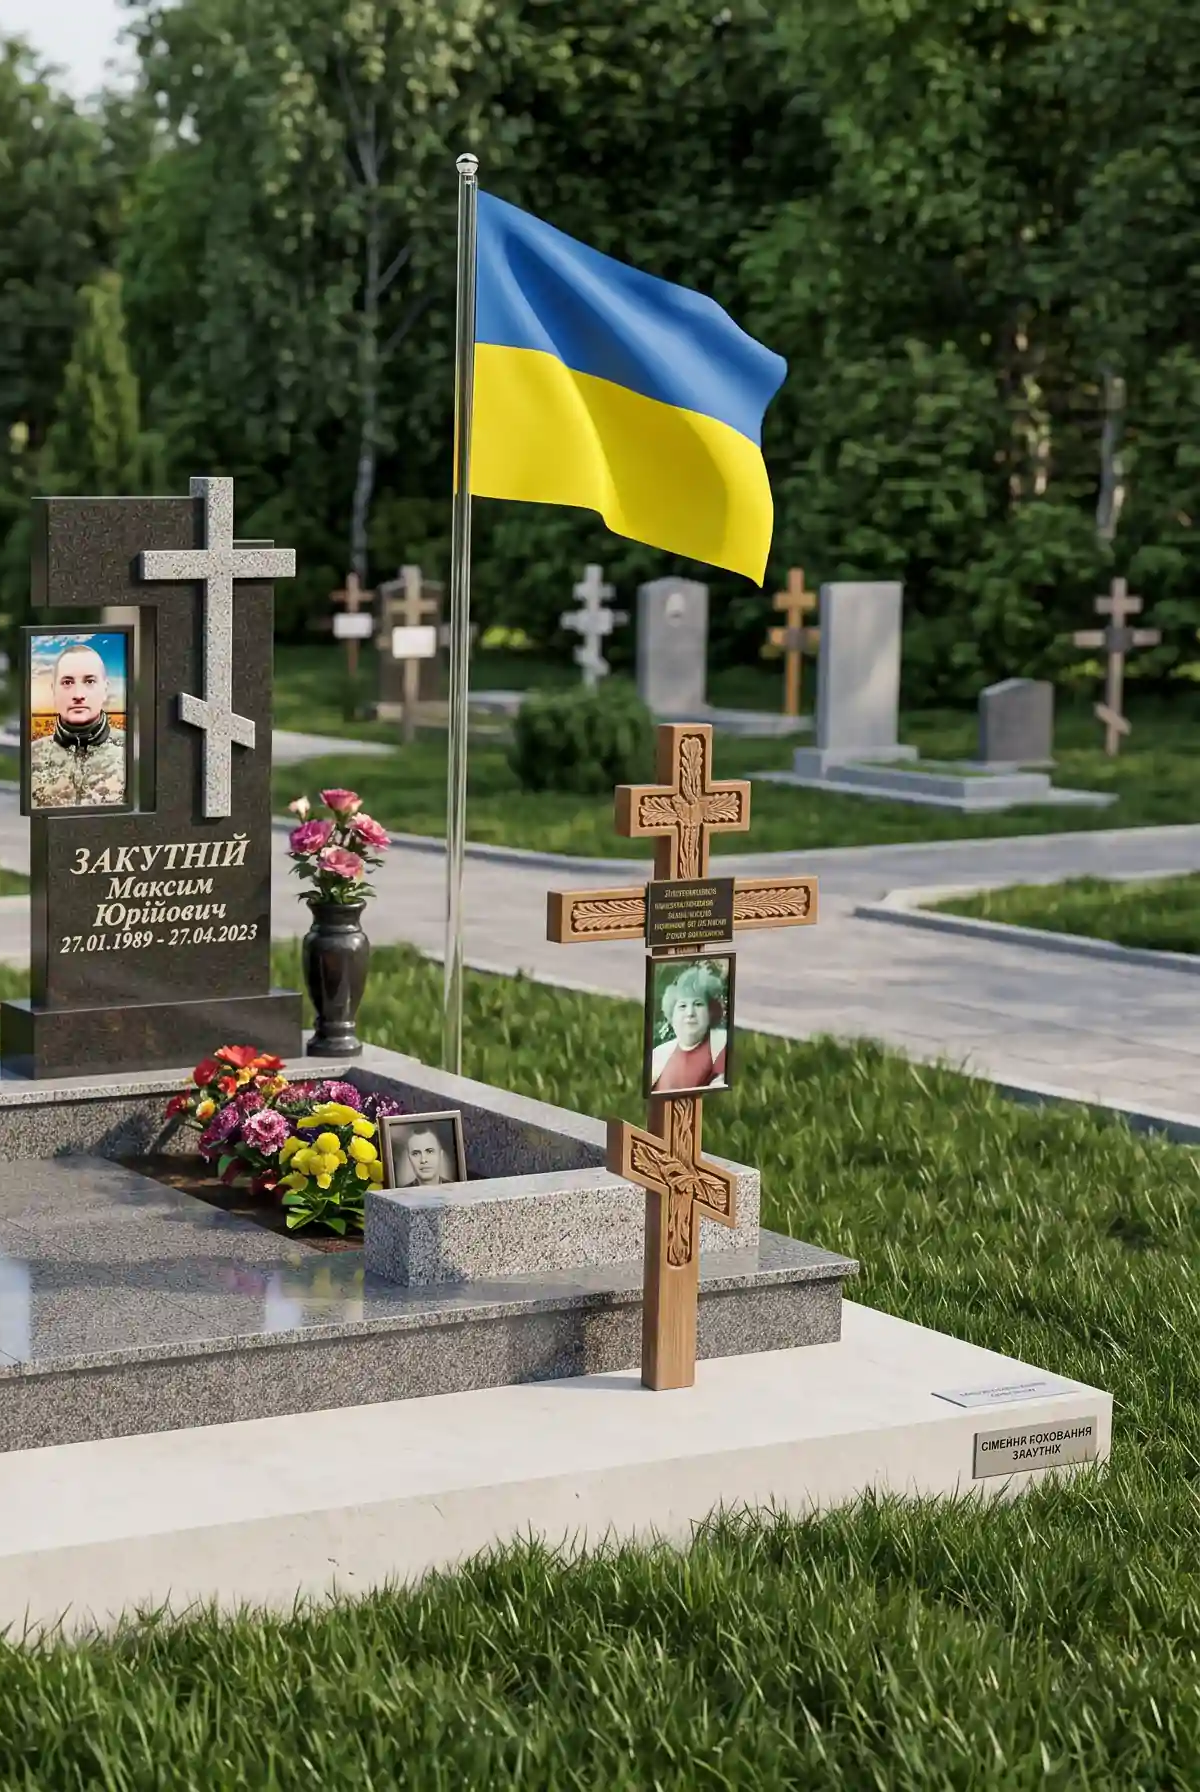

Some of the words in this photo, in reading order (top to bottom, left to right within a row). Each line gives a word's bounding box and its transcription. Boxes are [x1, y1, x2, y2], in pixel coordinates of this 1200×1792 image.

[70, 832, 251, 875] ЗАКУТНІЙ
[105, 875, 214, 900] Максим
[92, 901, 227, 931] Юрійович
[60, 930, 153, 953] 27.01.1989
[167, 924, 258, 947] 27.04.2023
